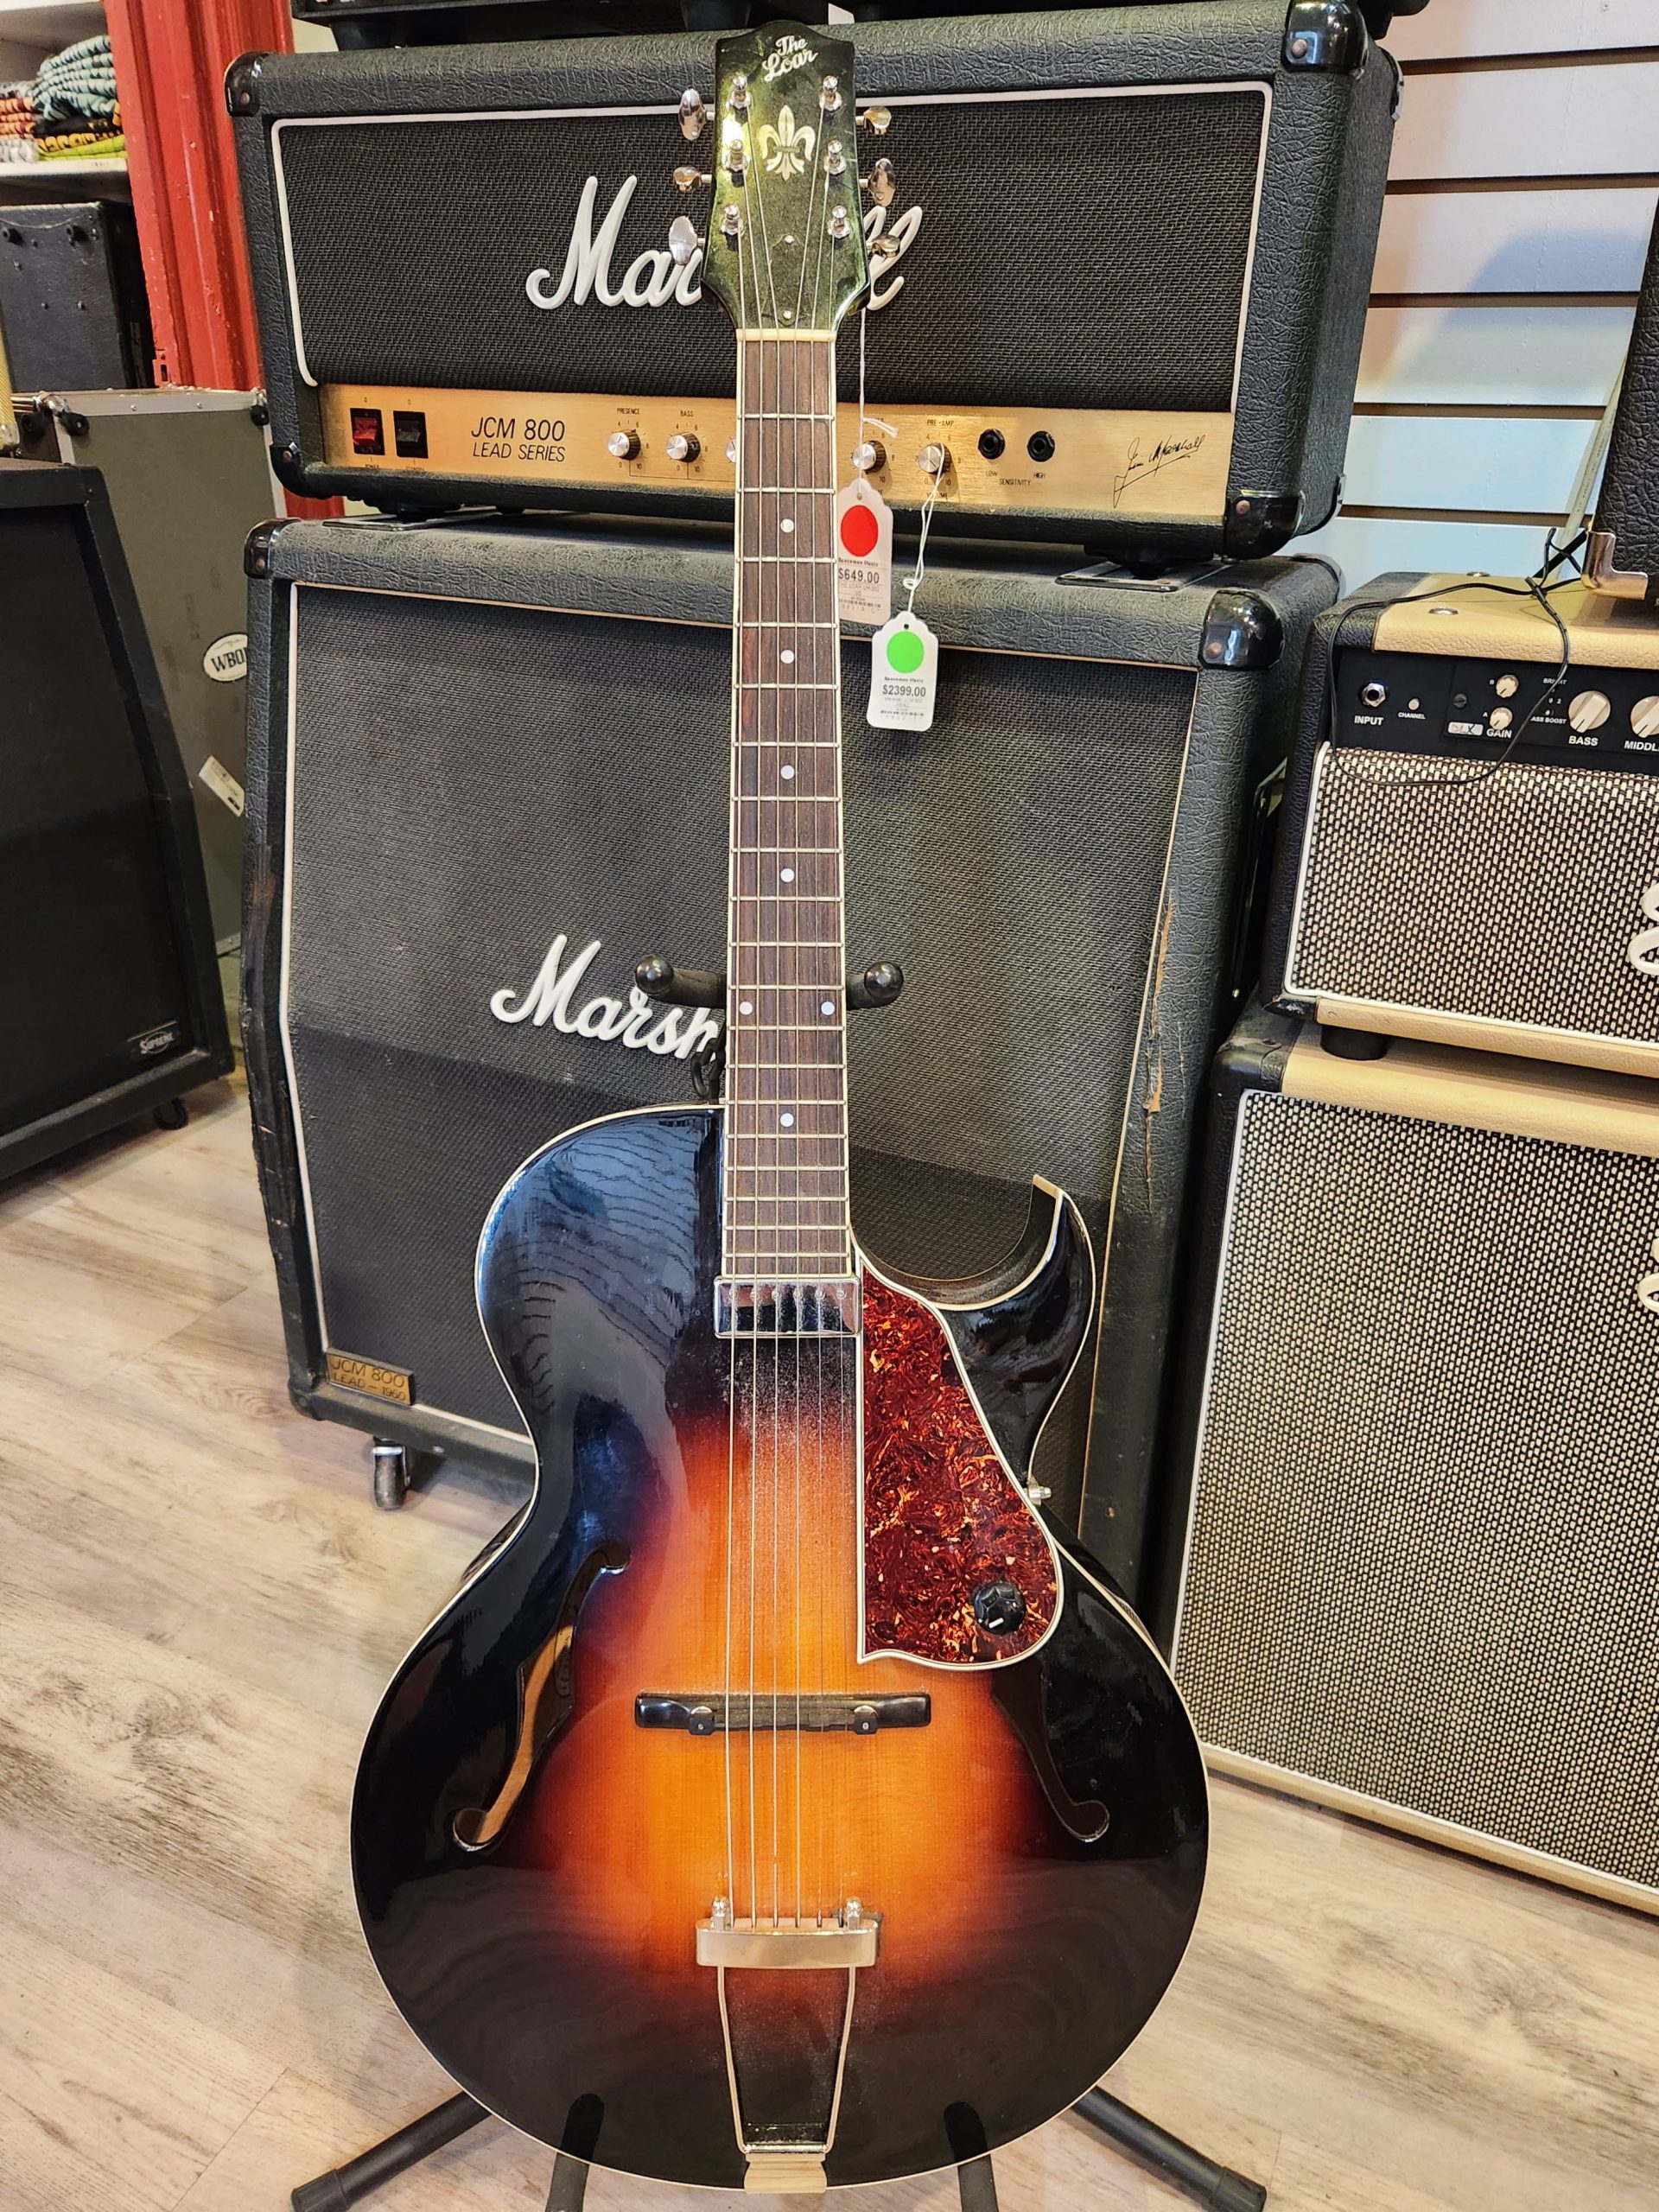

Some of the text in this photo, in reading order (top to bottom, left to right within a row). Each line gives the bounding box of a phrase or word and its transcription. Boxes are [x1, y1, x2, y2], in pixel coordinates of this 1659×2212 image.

[775, 35, 808, 56] The
[761, 48, 819, 83] Loar
[616, 407, 640, 416] PRESENCE
[471, 416, 566, 442] JCM 800
[473, 442, 566, 463] LEAD SERIES
[999, 478, 1032, 487] SENSITIVITY
[838, 567, 880, 584] $649.00
[882, 684, 926, 697] $2399.00
[1353, 715, 1384, 727] INPUT
[1397, 711, 1427, 720] CHANNEL
[1485, 728, 1513, 739] GAIN
[1568, 735, 1599, 747] BASS
[1624, 740, 1659, 753] MIDDL
[332, 1357, 405, 1389] JCM 800
[334, 1372, 366, 1389] LEAD
[382, 1386, 406, 1402] 1960
